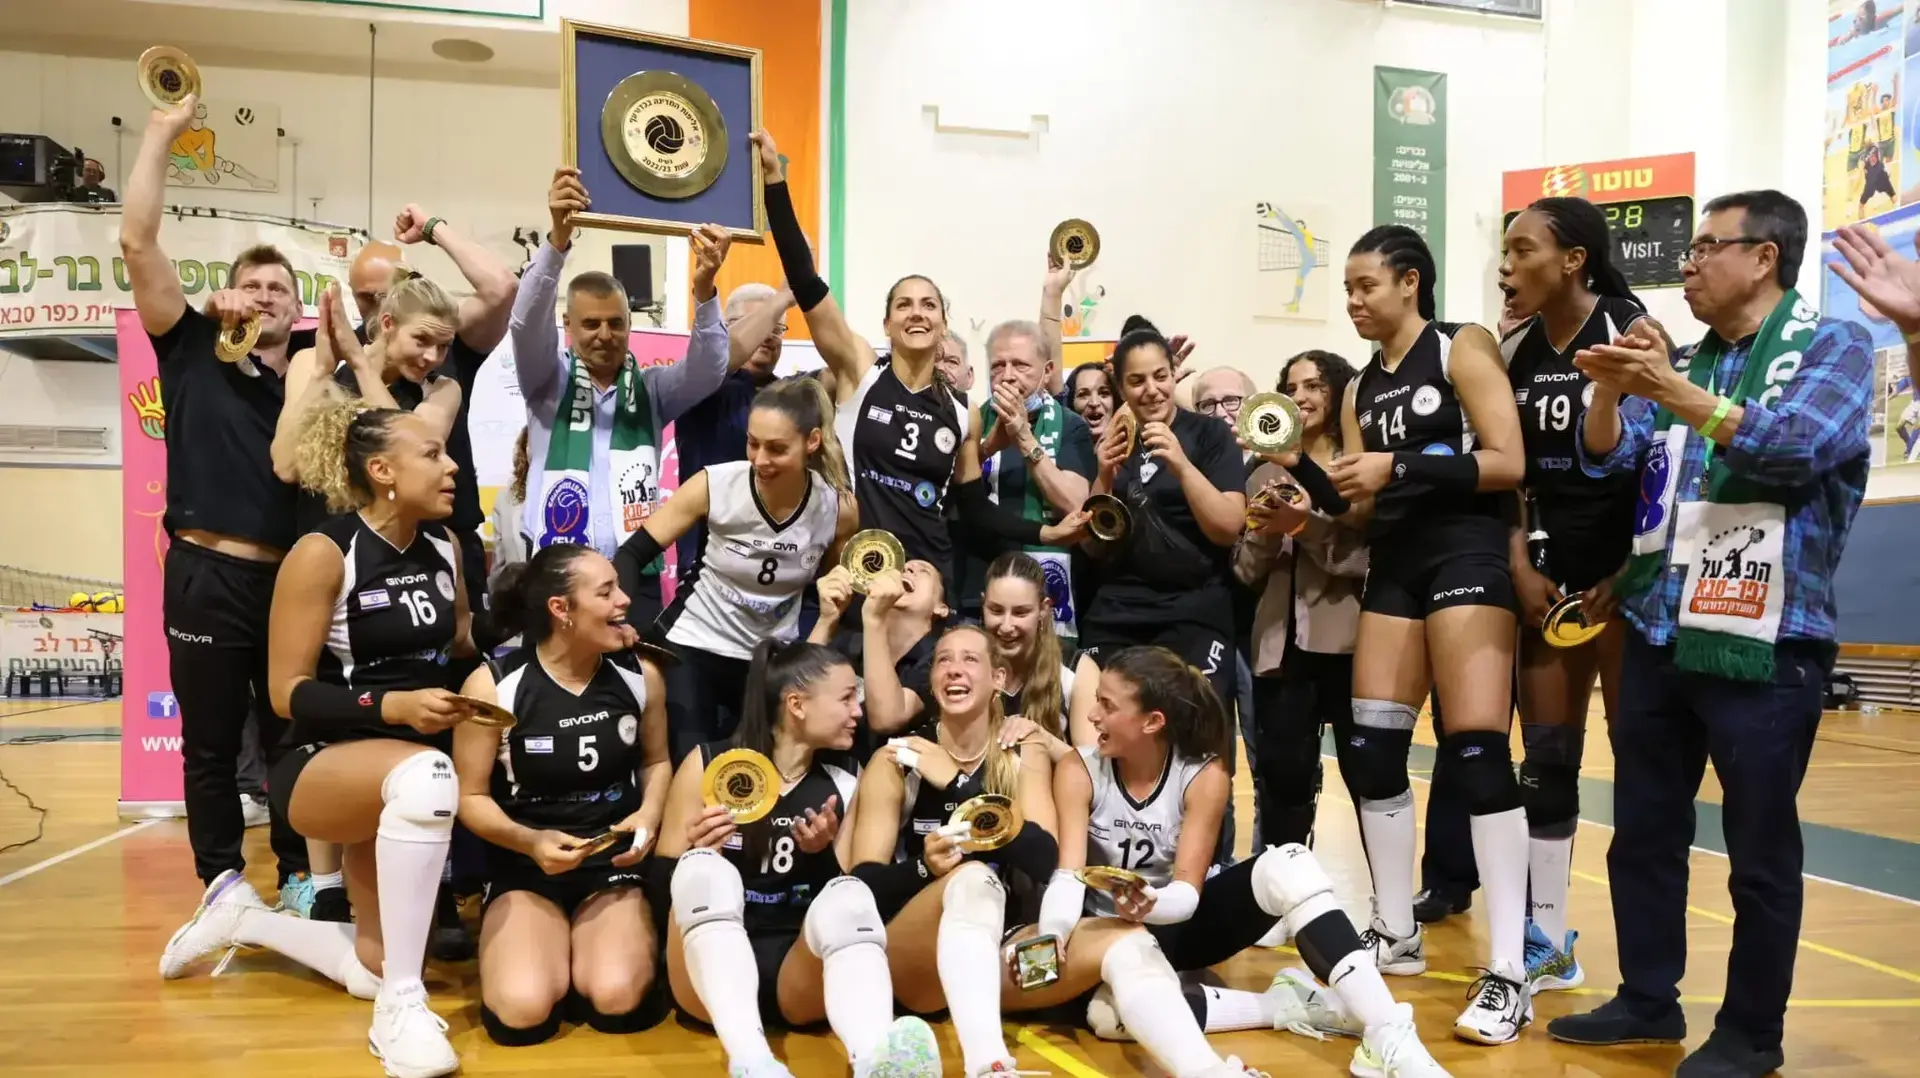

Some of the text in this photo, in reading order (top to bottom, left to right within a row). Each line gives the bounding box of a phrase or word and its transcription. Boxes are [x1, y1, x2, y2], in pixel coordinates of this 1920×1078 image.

[1592, 167, 1653, 193] טוטו
[1621, 241, 1665, 260] VISIT.
[1, 306, 35, 324] סבא
[41, 304, 79, 322] כפר
[1534, 372, 1579, 383] GIVOVA
[1374, 385, 1410, 403] GIVOVA
[895, 404, 933, 422] GIVOVA
[1535, 394, 1571, 431] 19
[1378, 405, 1406, 445] 14
[901, 422, 920, 451] 3
[385, 573, 429, 587] GIVOVA
[757, 557, 778, 585] 8
[1433, 586, 1485, 601] GIVOVA
[398, 590, 437, 627] 16
[558, 710, 610, 728] GIVOVA
[141, 736, 184, 752] ww
[577, 735, 600, 772] 5
[1113, 819, 1162, 832] GIVOVA
[1117, 838, 1154, 869] 12
